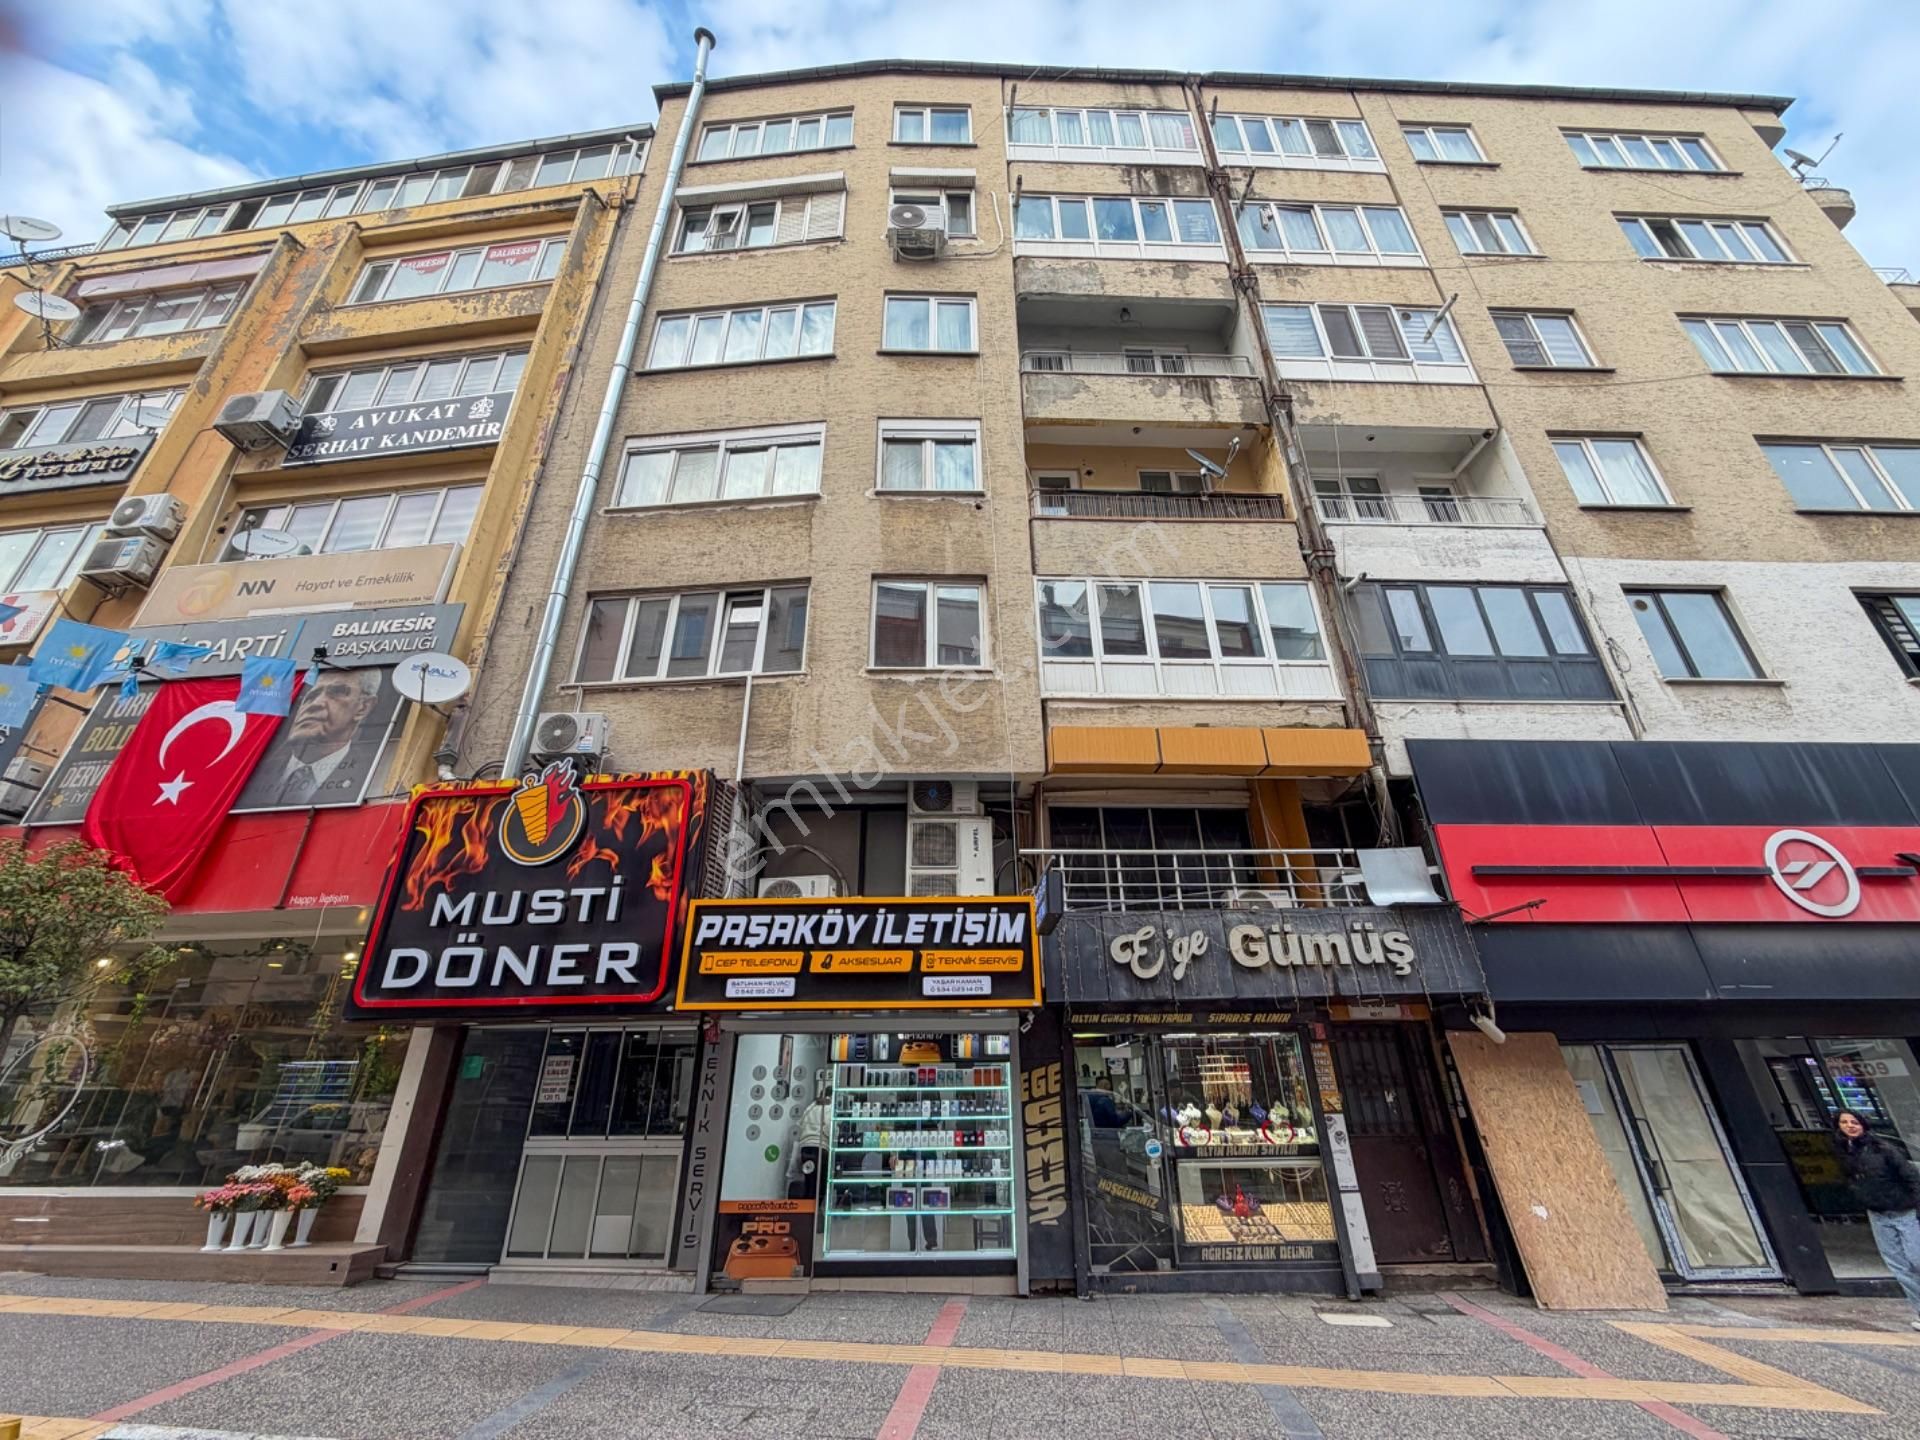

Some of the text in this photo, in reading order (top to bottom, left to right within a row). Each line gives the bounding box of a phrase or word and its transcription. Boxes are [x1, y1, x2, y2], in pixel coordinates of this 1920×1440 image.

[349, 402, 461, 430] AVUKAT
[288, 418, 502, 459] SERHAT KANDEMİR
[237, 570, 415, 597] NN Hayat ve Emeklilik
[332, 612, 437, 637] BALIKESİR
[335, 632, 439, 659] BAŞKANLIĞI
[289, 895, 319, 906] Happy
[429, 874, 625, 927] MUSTİ
[694, 907, 1026, 948] PAŞAKÖY İLETİŞİM
[381, 932, 641, 989] DÖNER
[938, 955, 1019, 966] TEKNİK SERVİS
[1229, 920, 1415, 976] Gümüş
[715, 957, 799, 968] CEP TELEFONU
[838, 956, 903, 967] AKSESUAR
[1071, 1014, 1100, 1024] ALTIN
[1161, 1013, 1193, 1023] YAPILIR
[1252, 1013, 1292, 1023] ALINIR
[1021, 1062, 1062, 1103] EGE
[1197, 1143, 1298, 1157] ALTIN ALINIR SATILIR
[742, 1222, 791, 1234] PRO
[1244, 1246, 1277, 1260] KULAK
